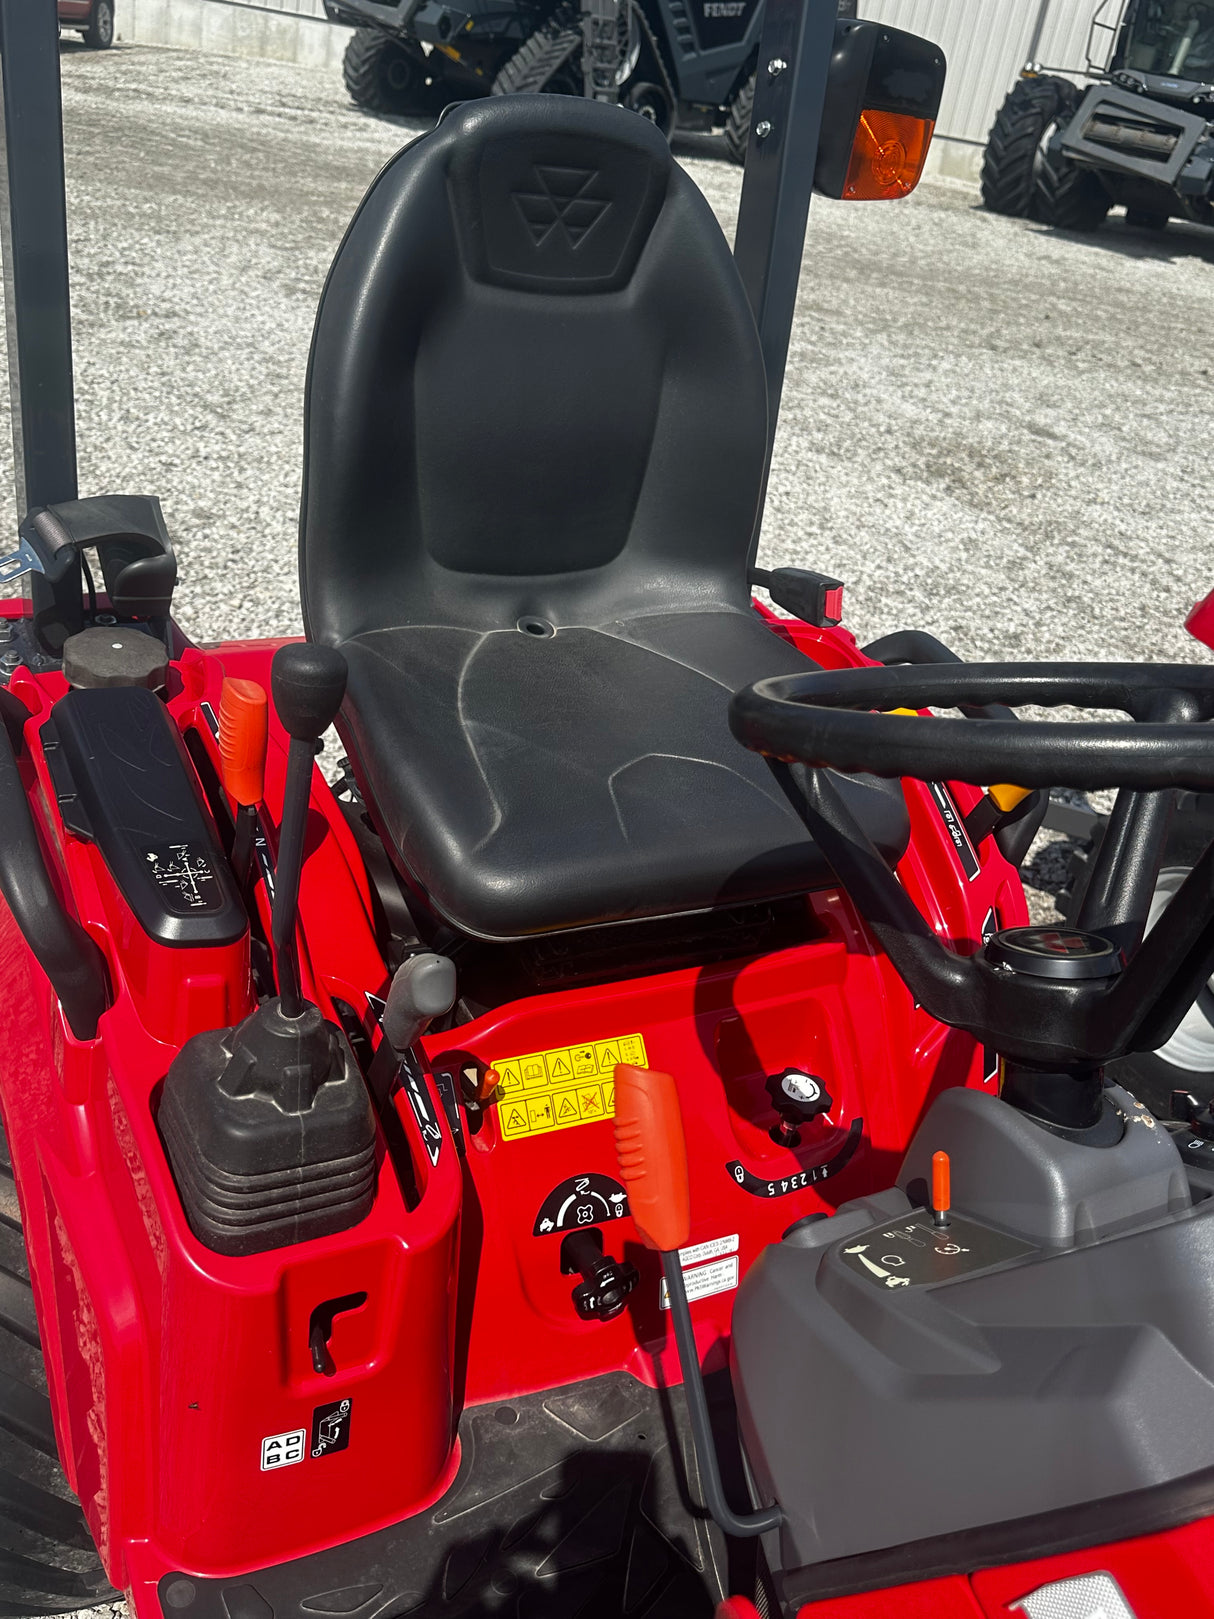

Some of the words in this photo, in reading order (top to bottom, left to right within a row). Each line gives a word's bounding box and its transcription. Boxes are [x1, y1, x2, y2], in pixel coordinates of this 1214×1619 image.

[703, 2, 746, 17] FENDT
[791, 1176, 798, 1189] 3
[800, 1173, 807, 1185] 2
[767, 1183, 775, 1196] 5
[781, 1181, 788, 1192] 4
